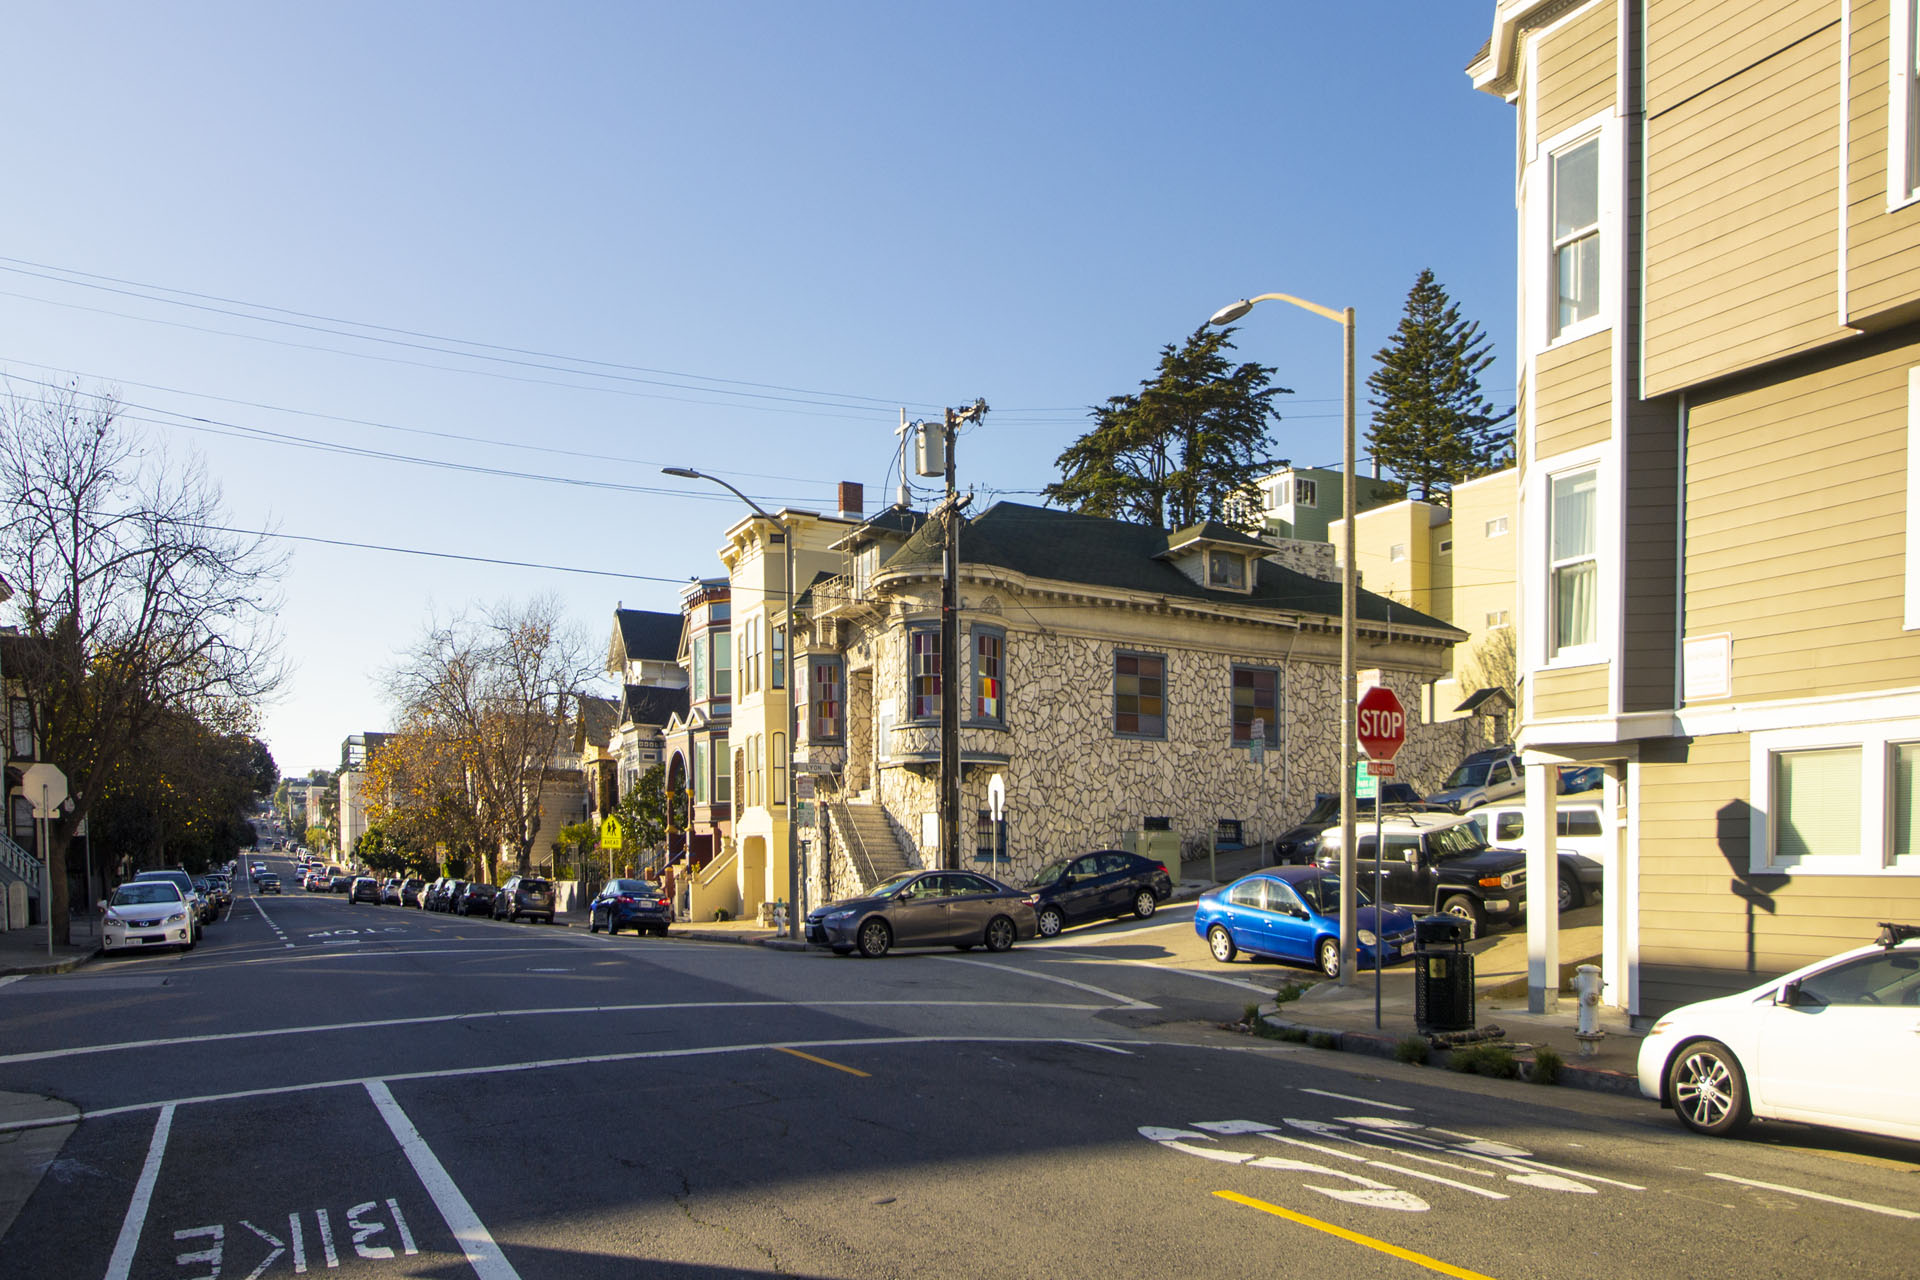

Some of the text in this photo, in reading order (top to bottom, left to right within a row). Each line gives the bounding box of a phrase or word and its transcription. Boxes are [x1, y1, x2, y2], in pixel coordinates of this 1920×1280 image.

[1360, 709, 1402, 738] STOP
[1368, 763, 1394, 775] ALL-WAY
[1137, 1116, 1648, 1212] STOP
[173, 1198, 420, 1280] BIKE
